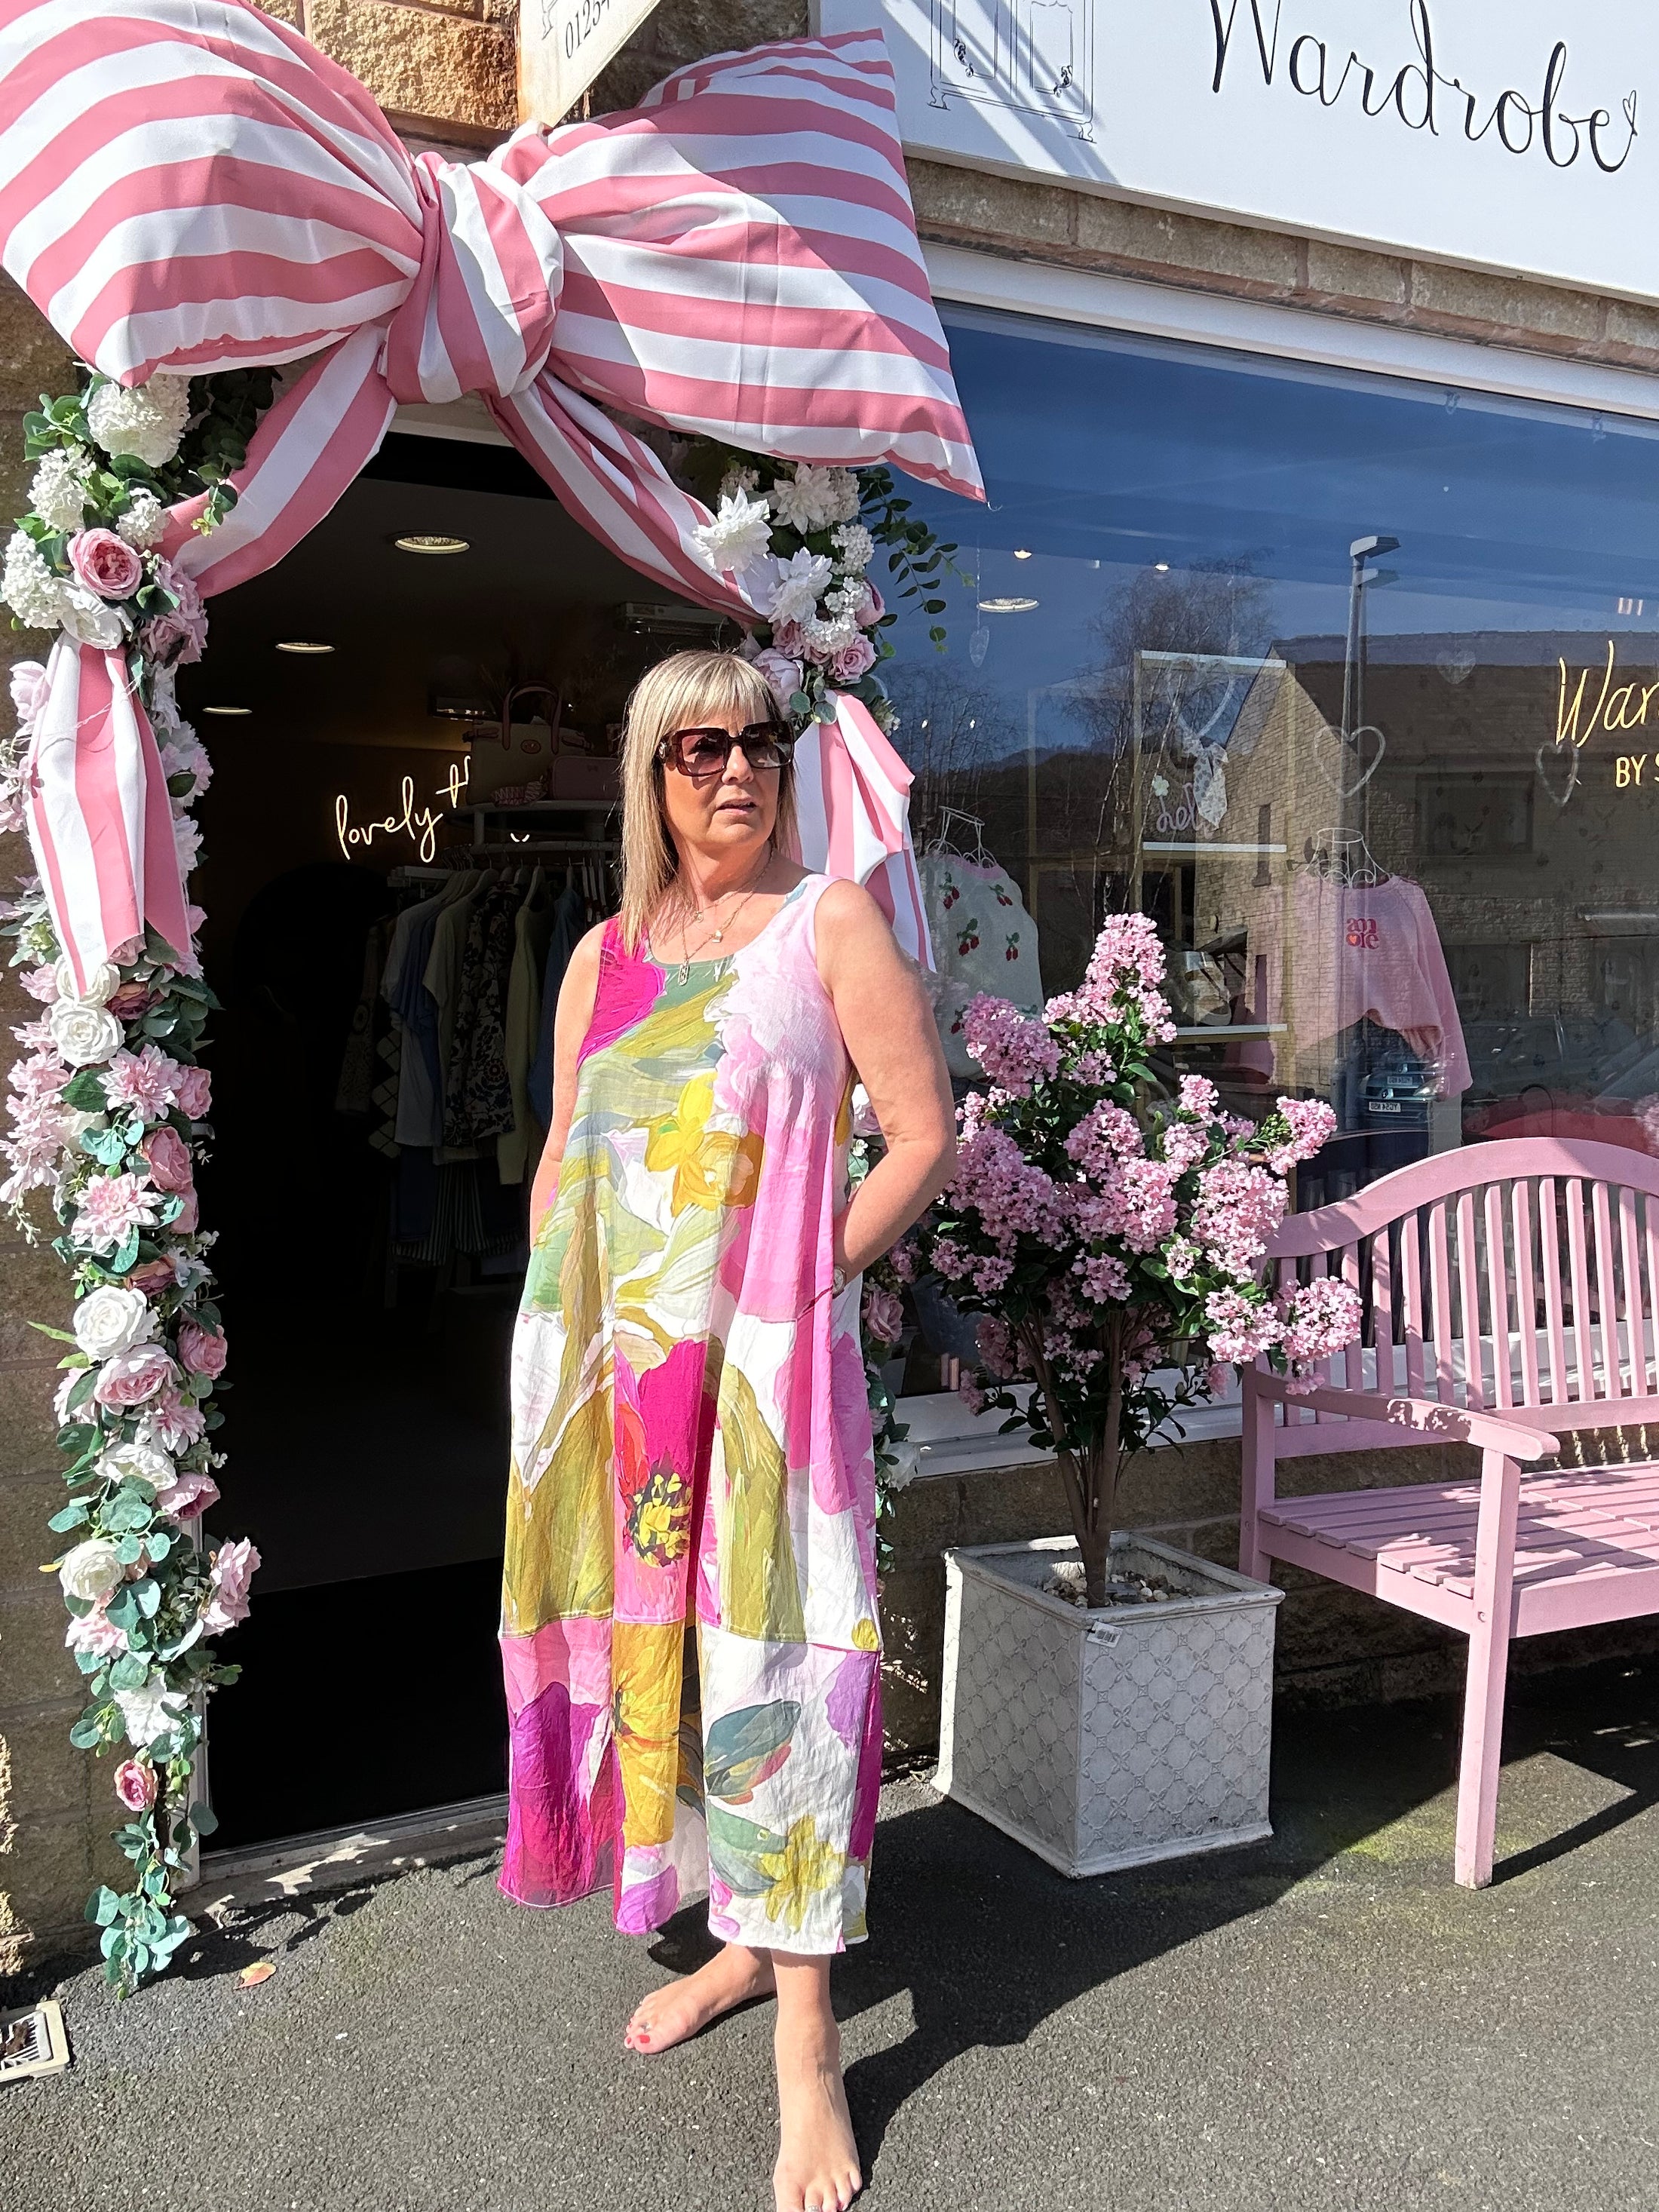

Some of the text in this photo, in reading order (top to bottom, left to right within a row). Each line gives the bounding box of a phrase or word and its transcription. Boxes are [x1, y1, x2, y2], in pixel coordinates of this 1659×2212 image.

[1210, 0, 1637, 173] Wardrobe
[1556, 640, 1659, 748] War
[336, 775, 443, 863] lovely
[1616, 753, 1648, 788] BY
